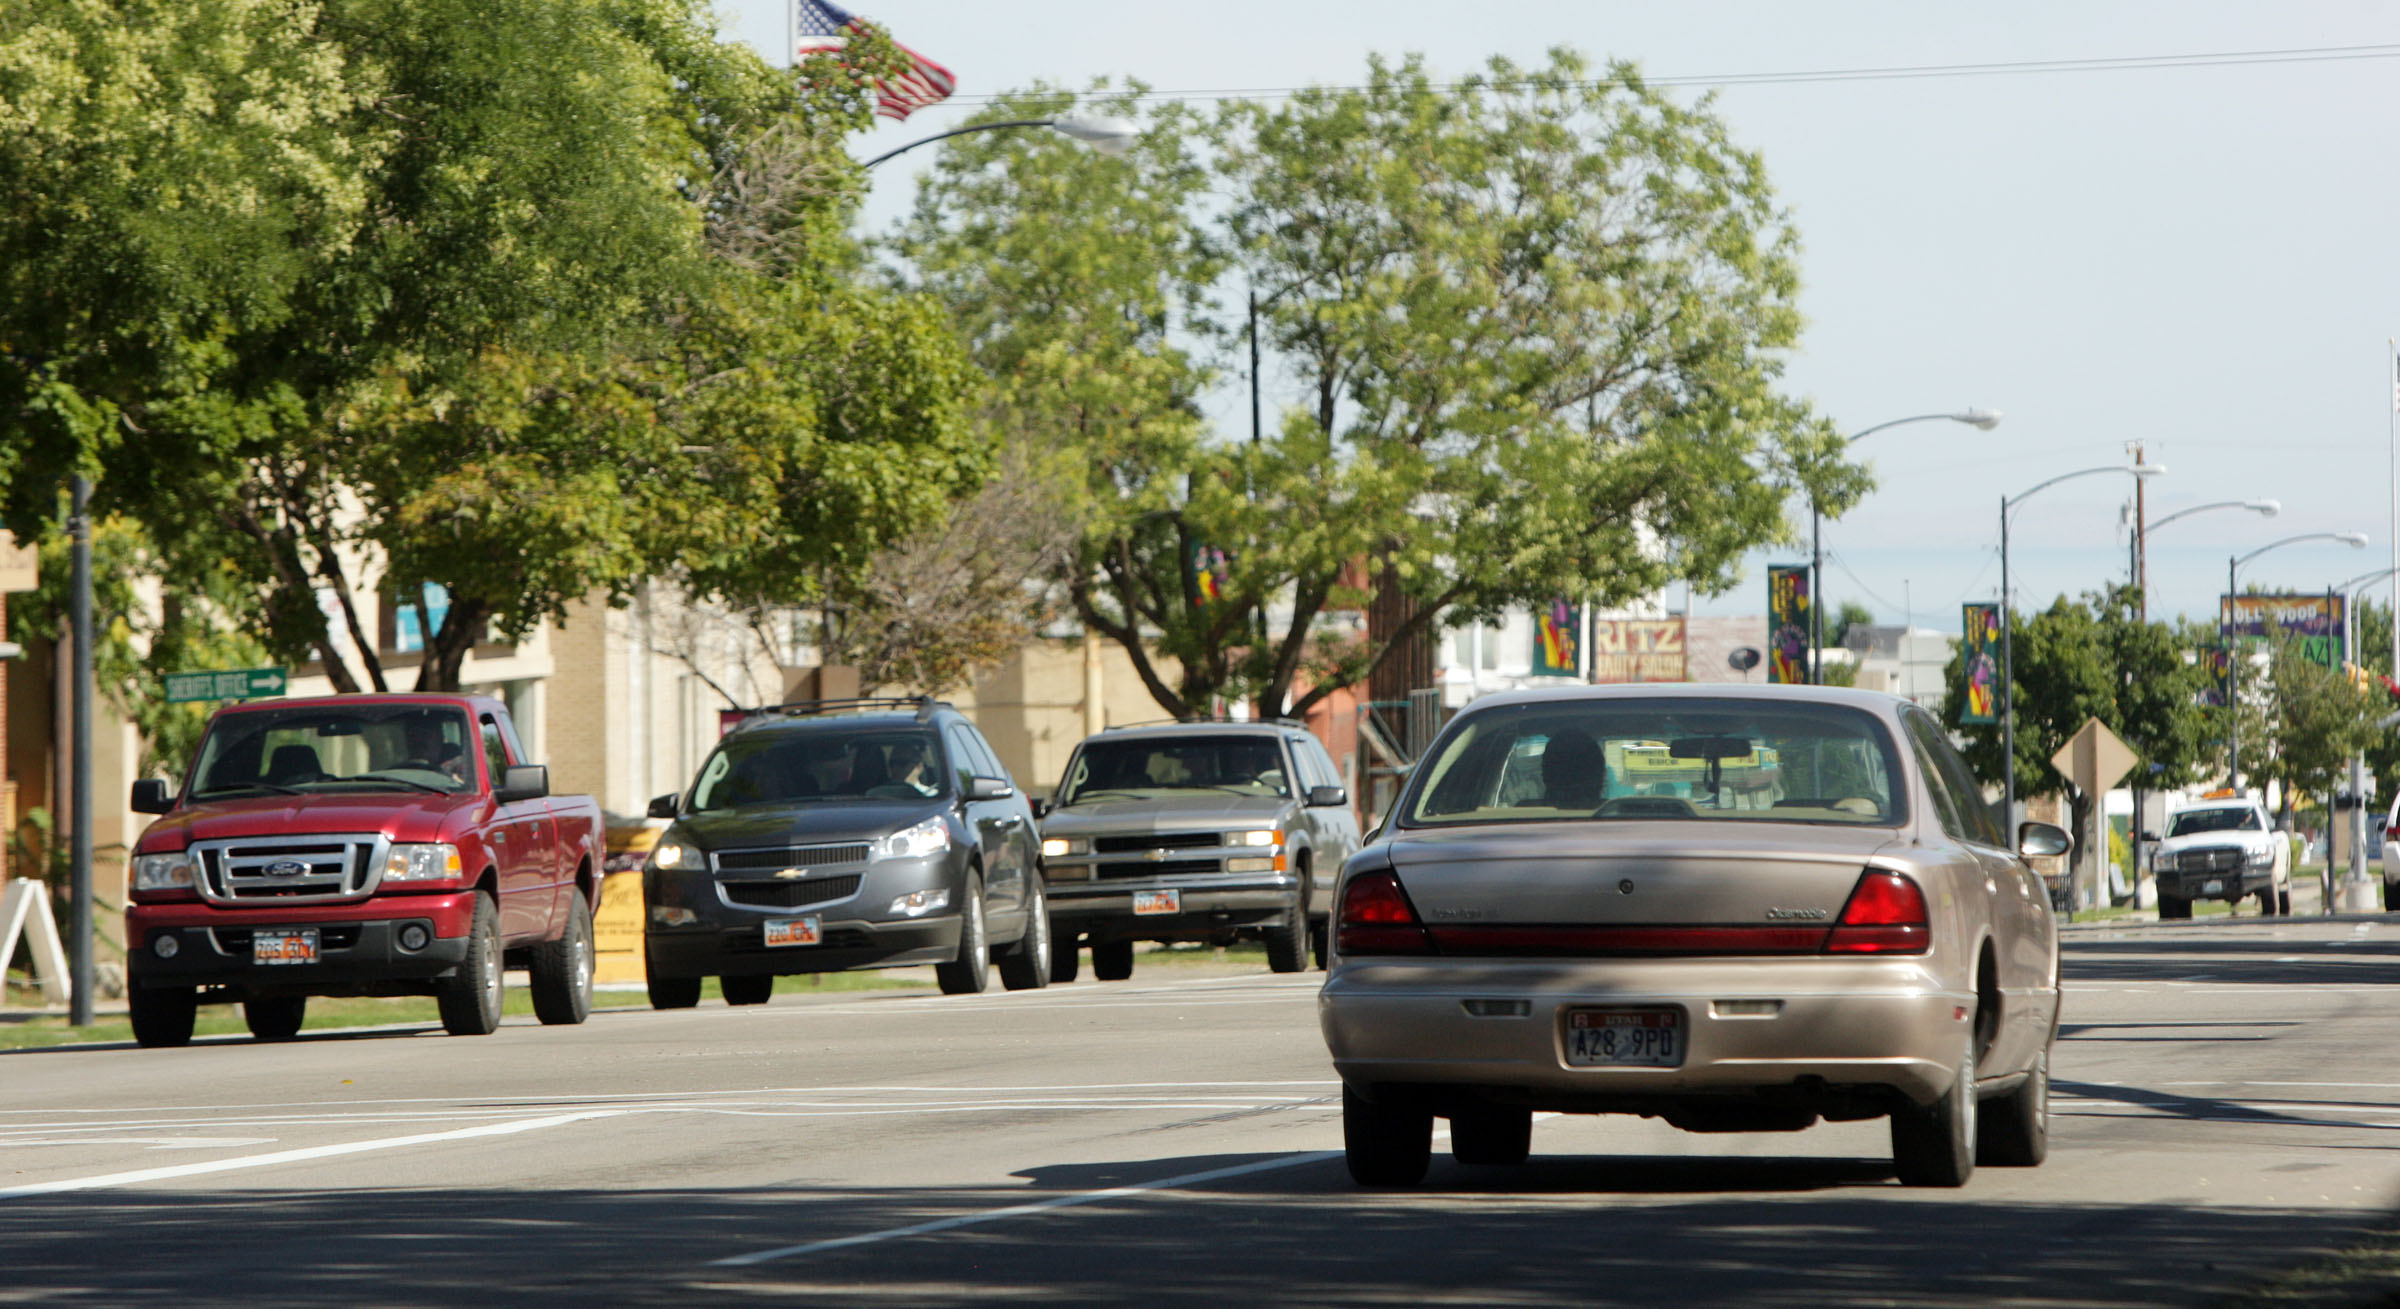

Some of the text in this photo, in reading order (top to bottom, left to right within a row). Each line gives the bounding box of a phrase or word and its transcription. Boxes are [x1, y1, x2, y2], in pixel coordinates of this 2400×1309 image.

[1597, 620, 1682, 653] RITZ
[215, 672, 249, 697] OFFICE
[272, 862, 300, 875] Ford
[1575, 1029, 1616, 1056] A28
